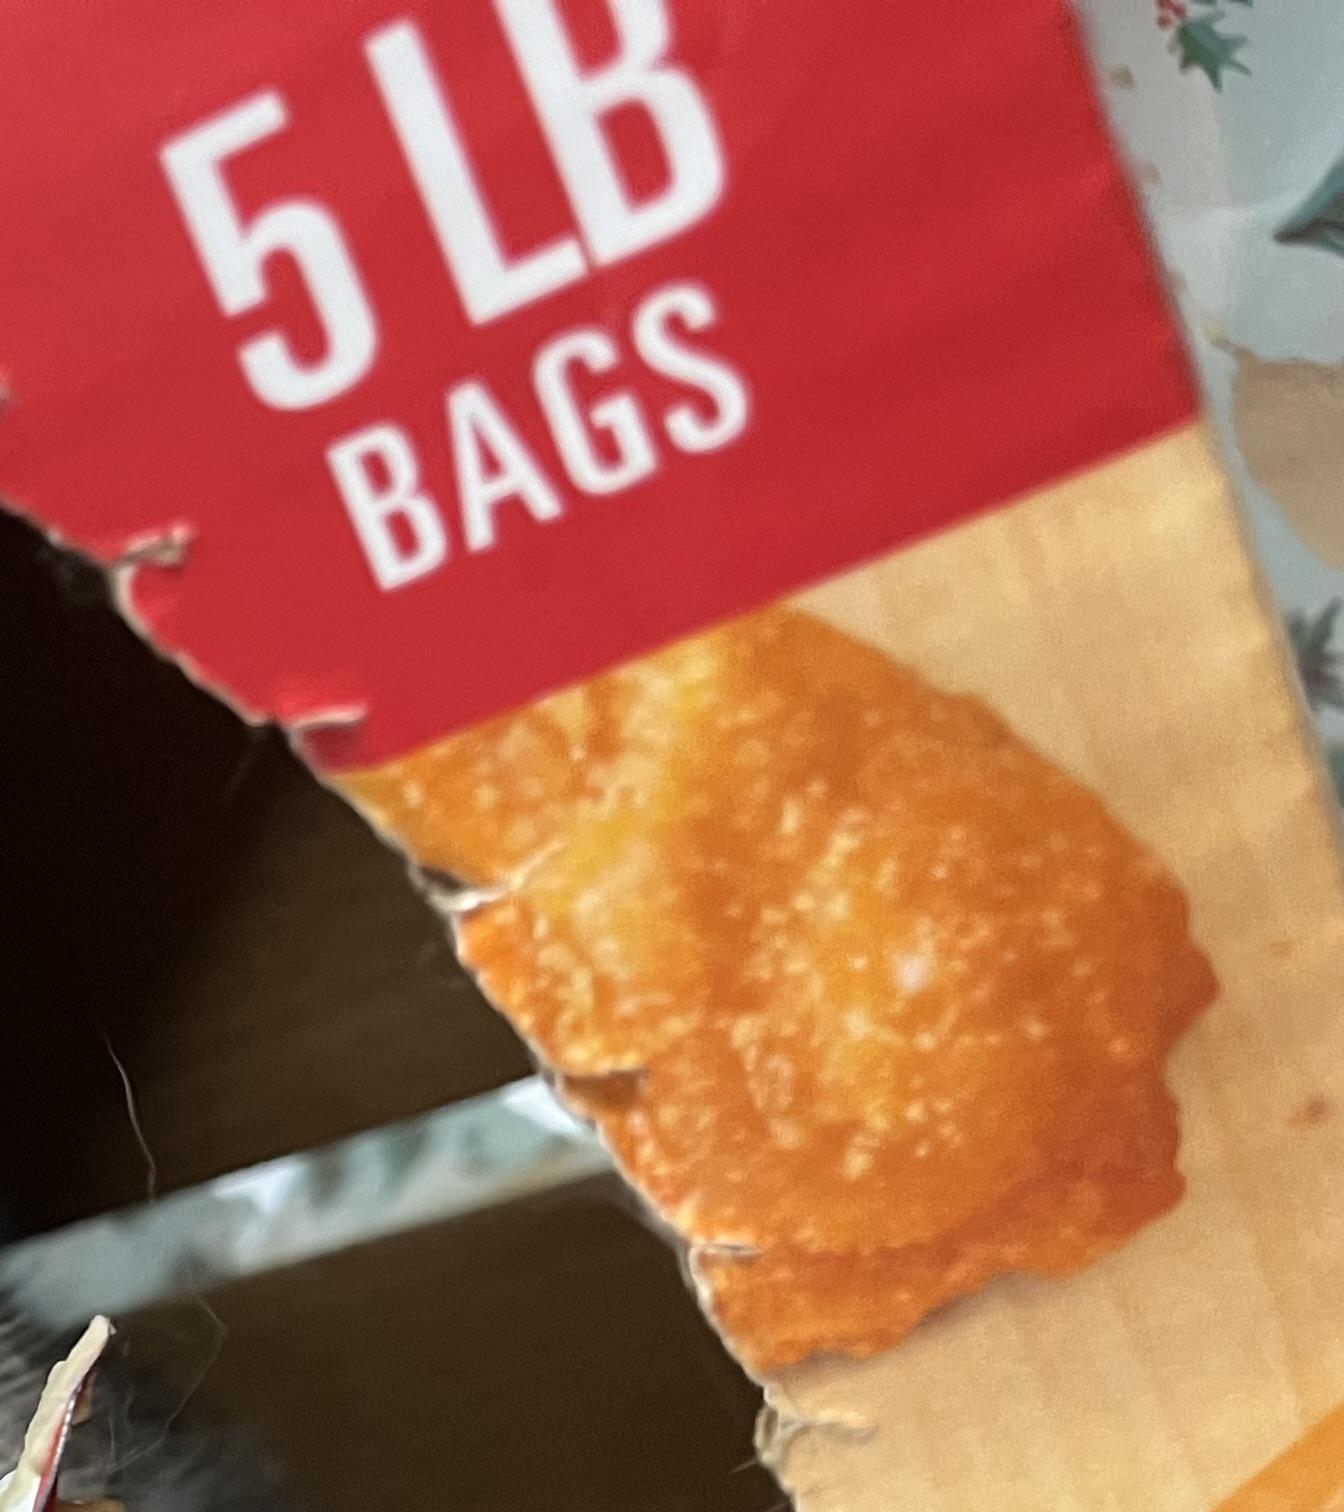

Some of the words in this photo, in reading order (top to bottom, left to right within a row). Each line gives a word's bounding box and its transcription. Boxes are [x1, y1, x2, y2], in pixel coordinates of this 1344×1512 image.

[159, 86, 380, 410] 5
[362, 0, 728, 328] LB
[326, 281, 752, 592] BAGS
